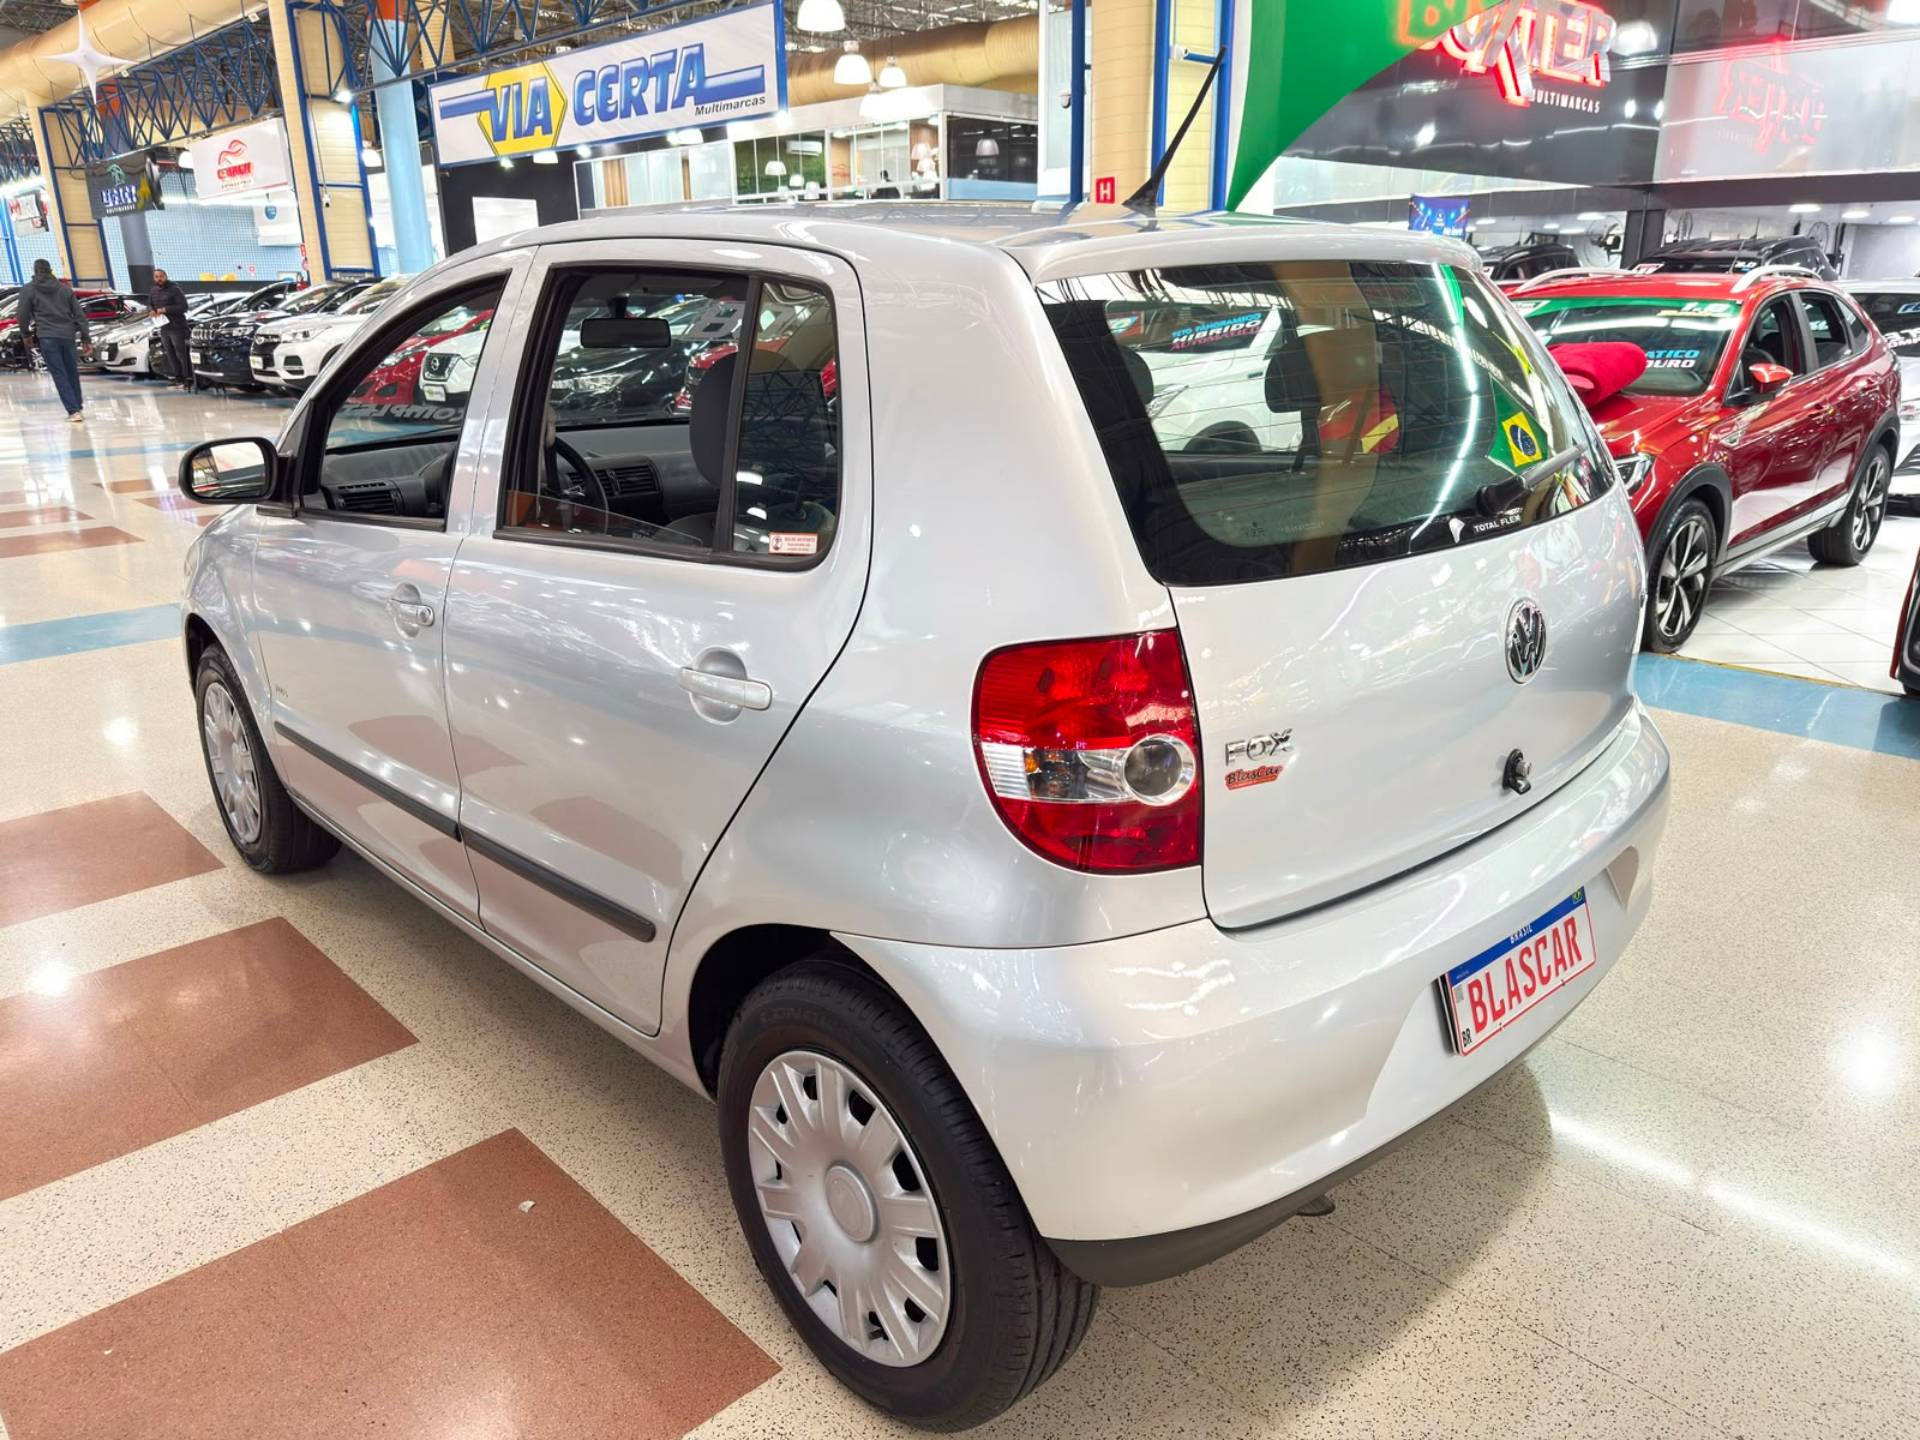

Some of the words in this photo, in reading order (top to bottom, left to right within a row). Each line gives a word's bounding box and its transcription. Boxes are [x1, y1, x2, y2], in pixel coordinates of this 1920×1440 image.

[486, 75, 553, 142] VIA
[572, 42, 709, 127] CERTA
[694, 95, 767, 117] Multimarcas
[1474, 520, 1500, 533] TOTAL
[1225, 728, 1293, 767] FOX
[1467, 916, 1582, 1034] BLASCAR
[1461, 1027, 1472, 1048] BR
